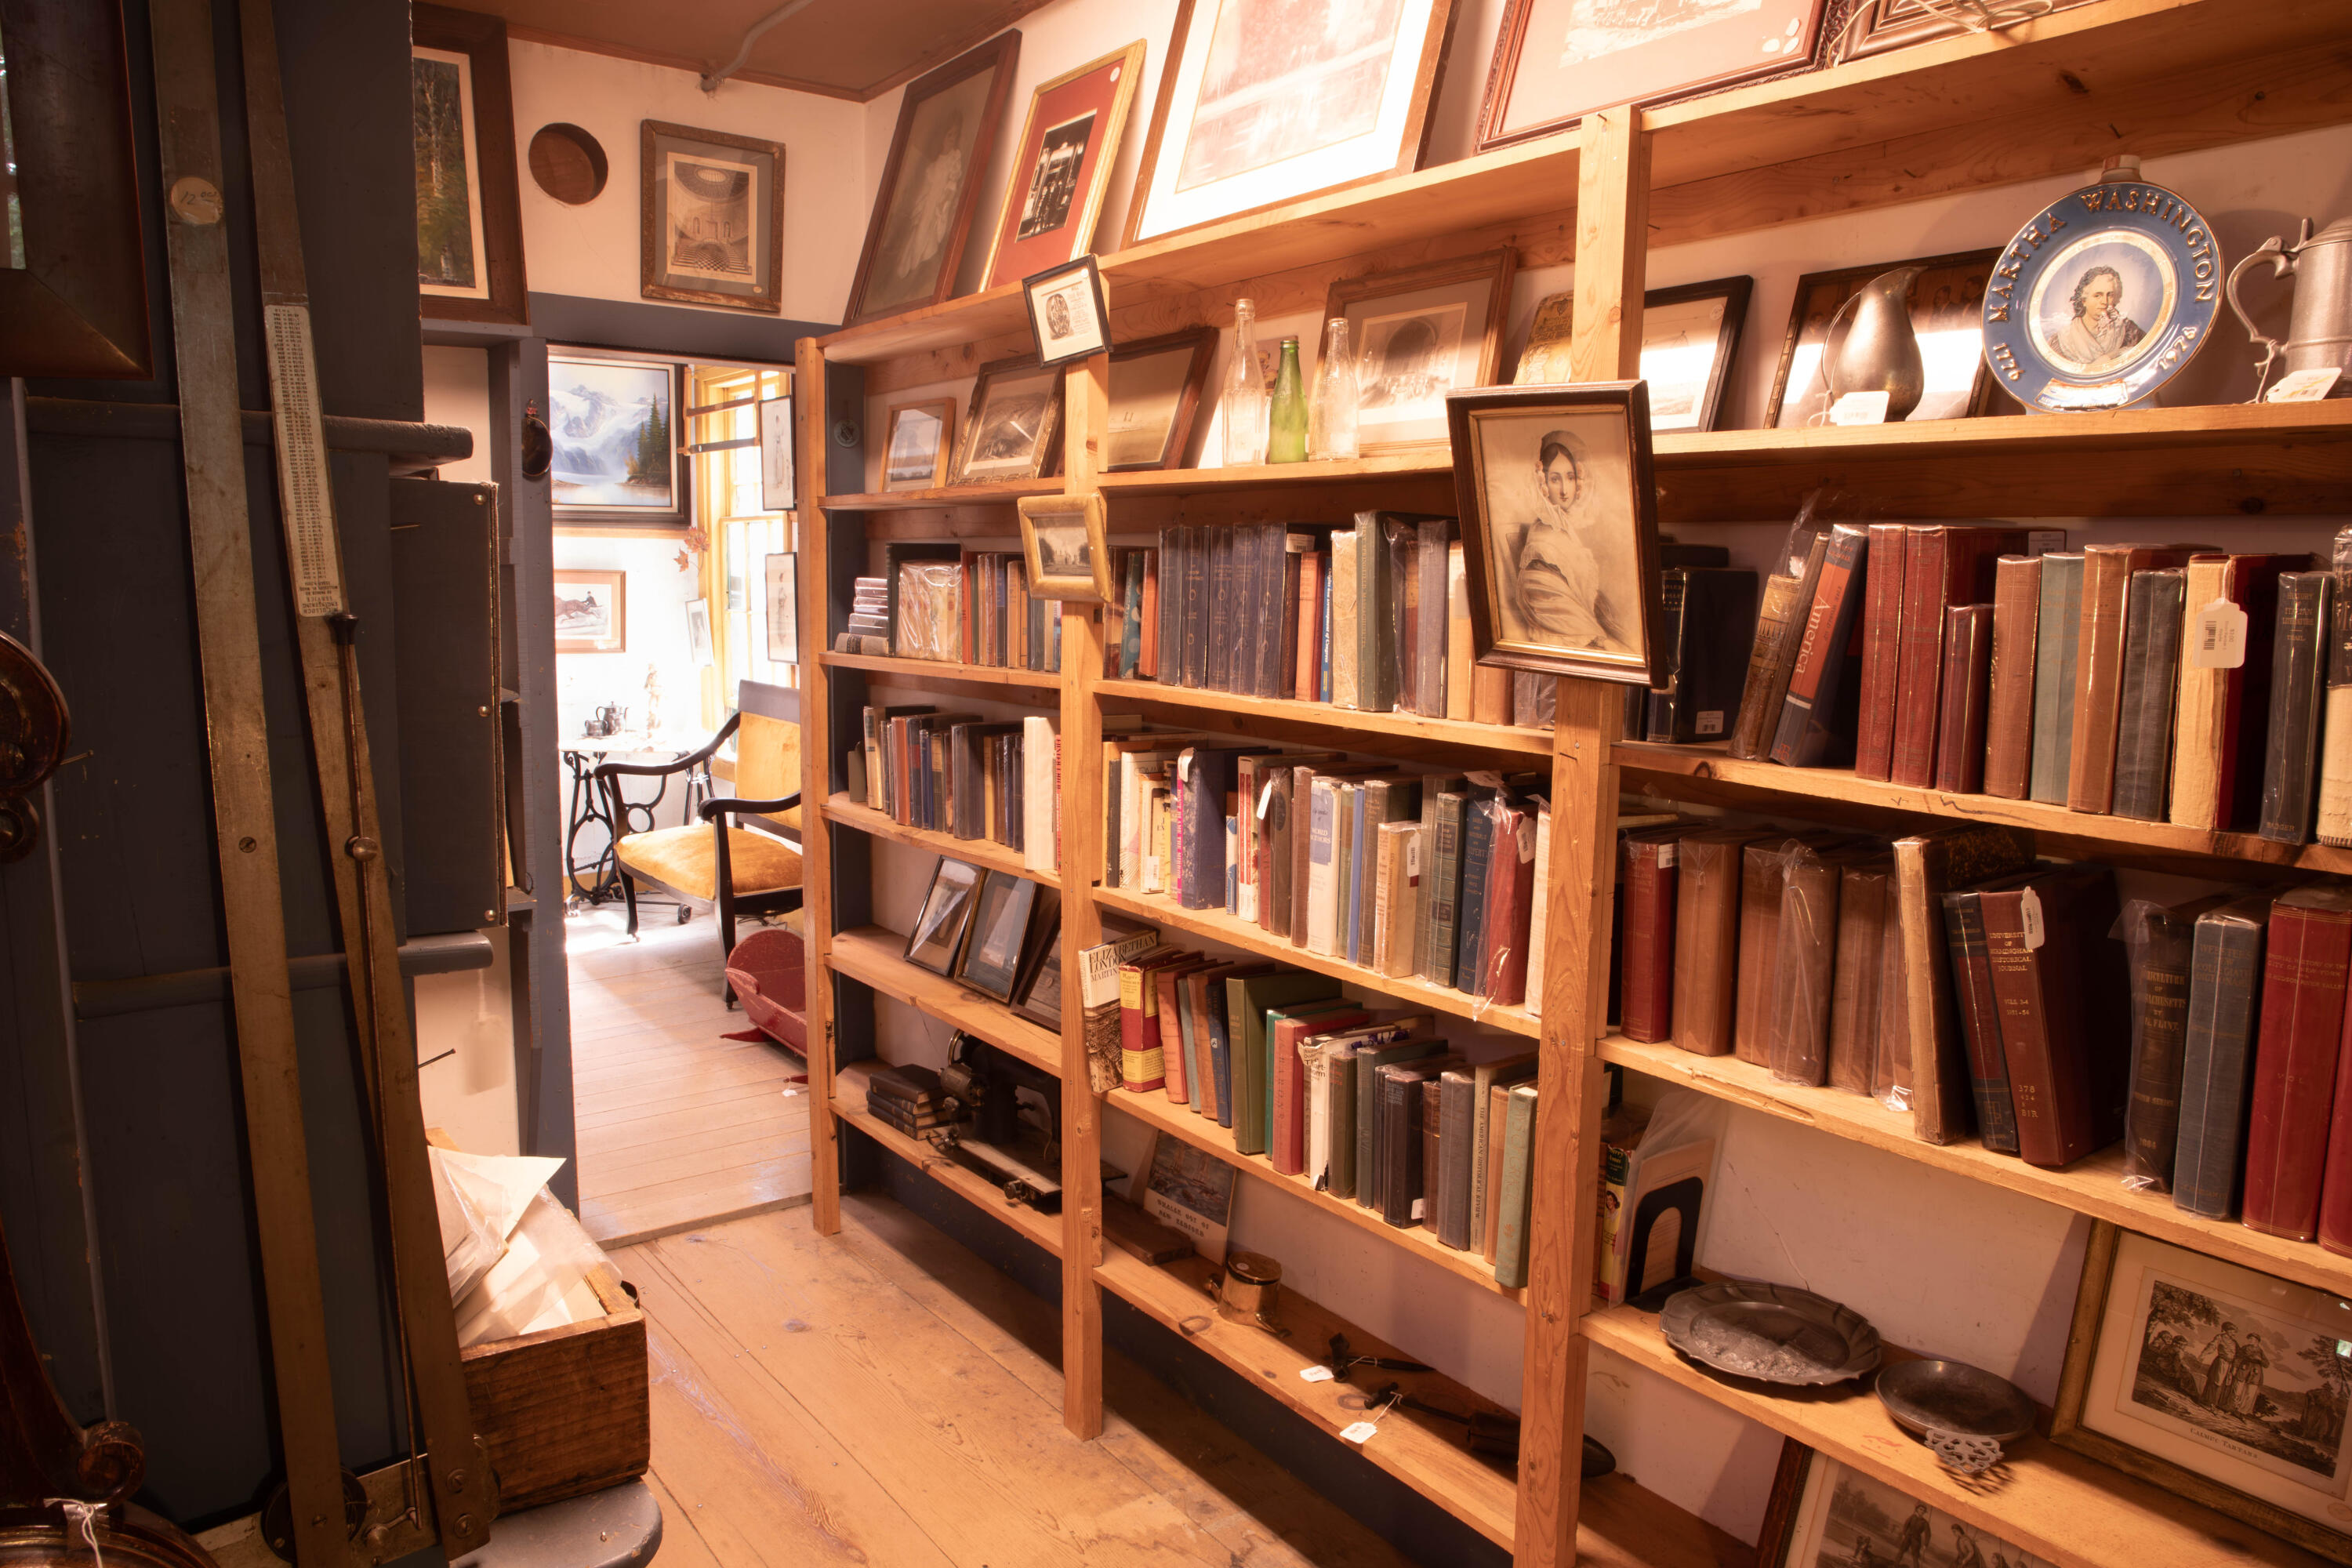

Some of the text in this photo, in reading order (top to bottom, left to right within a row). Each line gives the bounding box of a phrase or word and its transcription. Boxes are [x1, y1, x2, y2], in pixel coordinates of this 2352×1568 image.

[2080, 188, 2216, 304] WASHINGTON
[1987, 212, 2067, 324] MARTHA
[1993, 343, 2027, 383] 1776
[1795, 593, 1831, 675] America
[1310, 834, 1331, 845] AUTHORS
[1312, 827, 1328, 837] WORLD
[1089, 935, 1156, 964] ELIZABETHAN
[1090, 953, 1126, 975] LONDON
[1091, 967, 1117, 983] MARTIN
[2142, 971, 2186, 986] RICULTURE
[2144, 993, 2187, 1009] SACHUSETTS
[2019, 1084, 2035, 1094] 378
[2021, 1109, 2038, 1118] BIR
